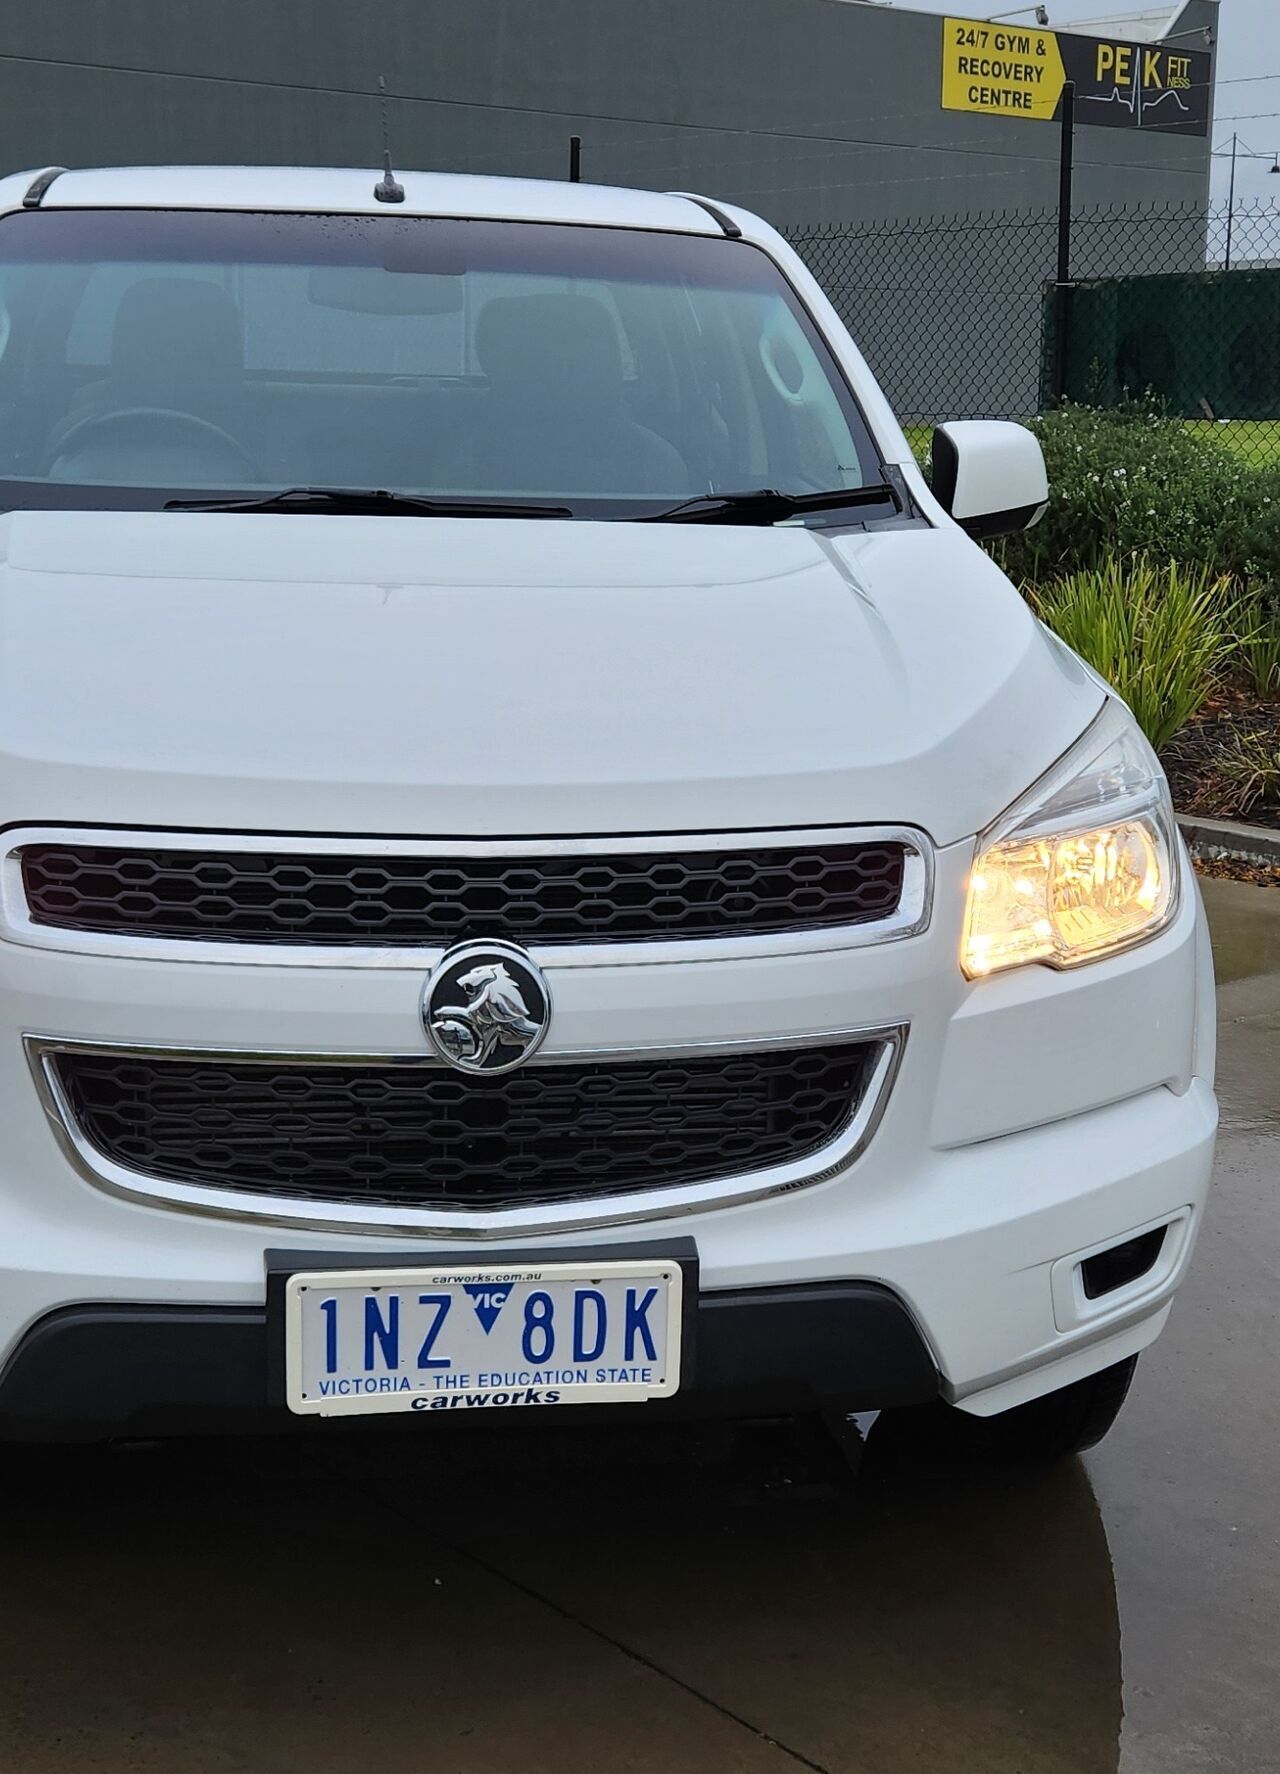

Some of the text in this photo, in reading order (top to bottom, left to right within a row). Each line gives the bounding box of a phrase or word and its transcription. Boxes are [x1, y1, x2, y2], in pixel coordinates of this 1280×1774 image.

[956, 28, 1046, 56] 24/7 GYM &
[958, 56, 1044, 83] RECOVERY
[1168, 56, 1191, 77] FIT
[1167, 76, 1190, 90] NESS
[968, 86, 1032, 109] CENTRE
[432, 1272, 542, 1284] carworks.com.au
[467, 1292, 507, 1309] VIC
[320, 1286, 658, 1374] 1NZ 8DK
[320, 1376, 411, 1395] VICTORIA
[433, 1374, 470, 1390] THE
[478, 1369, 588, 1388] EDUCATION
[595, 1368, 652, 1384] STATE
[410, 1388, 561, 1410] carworks
